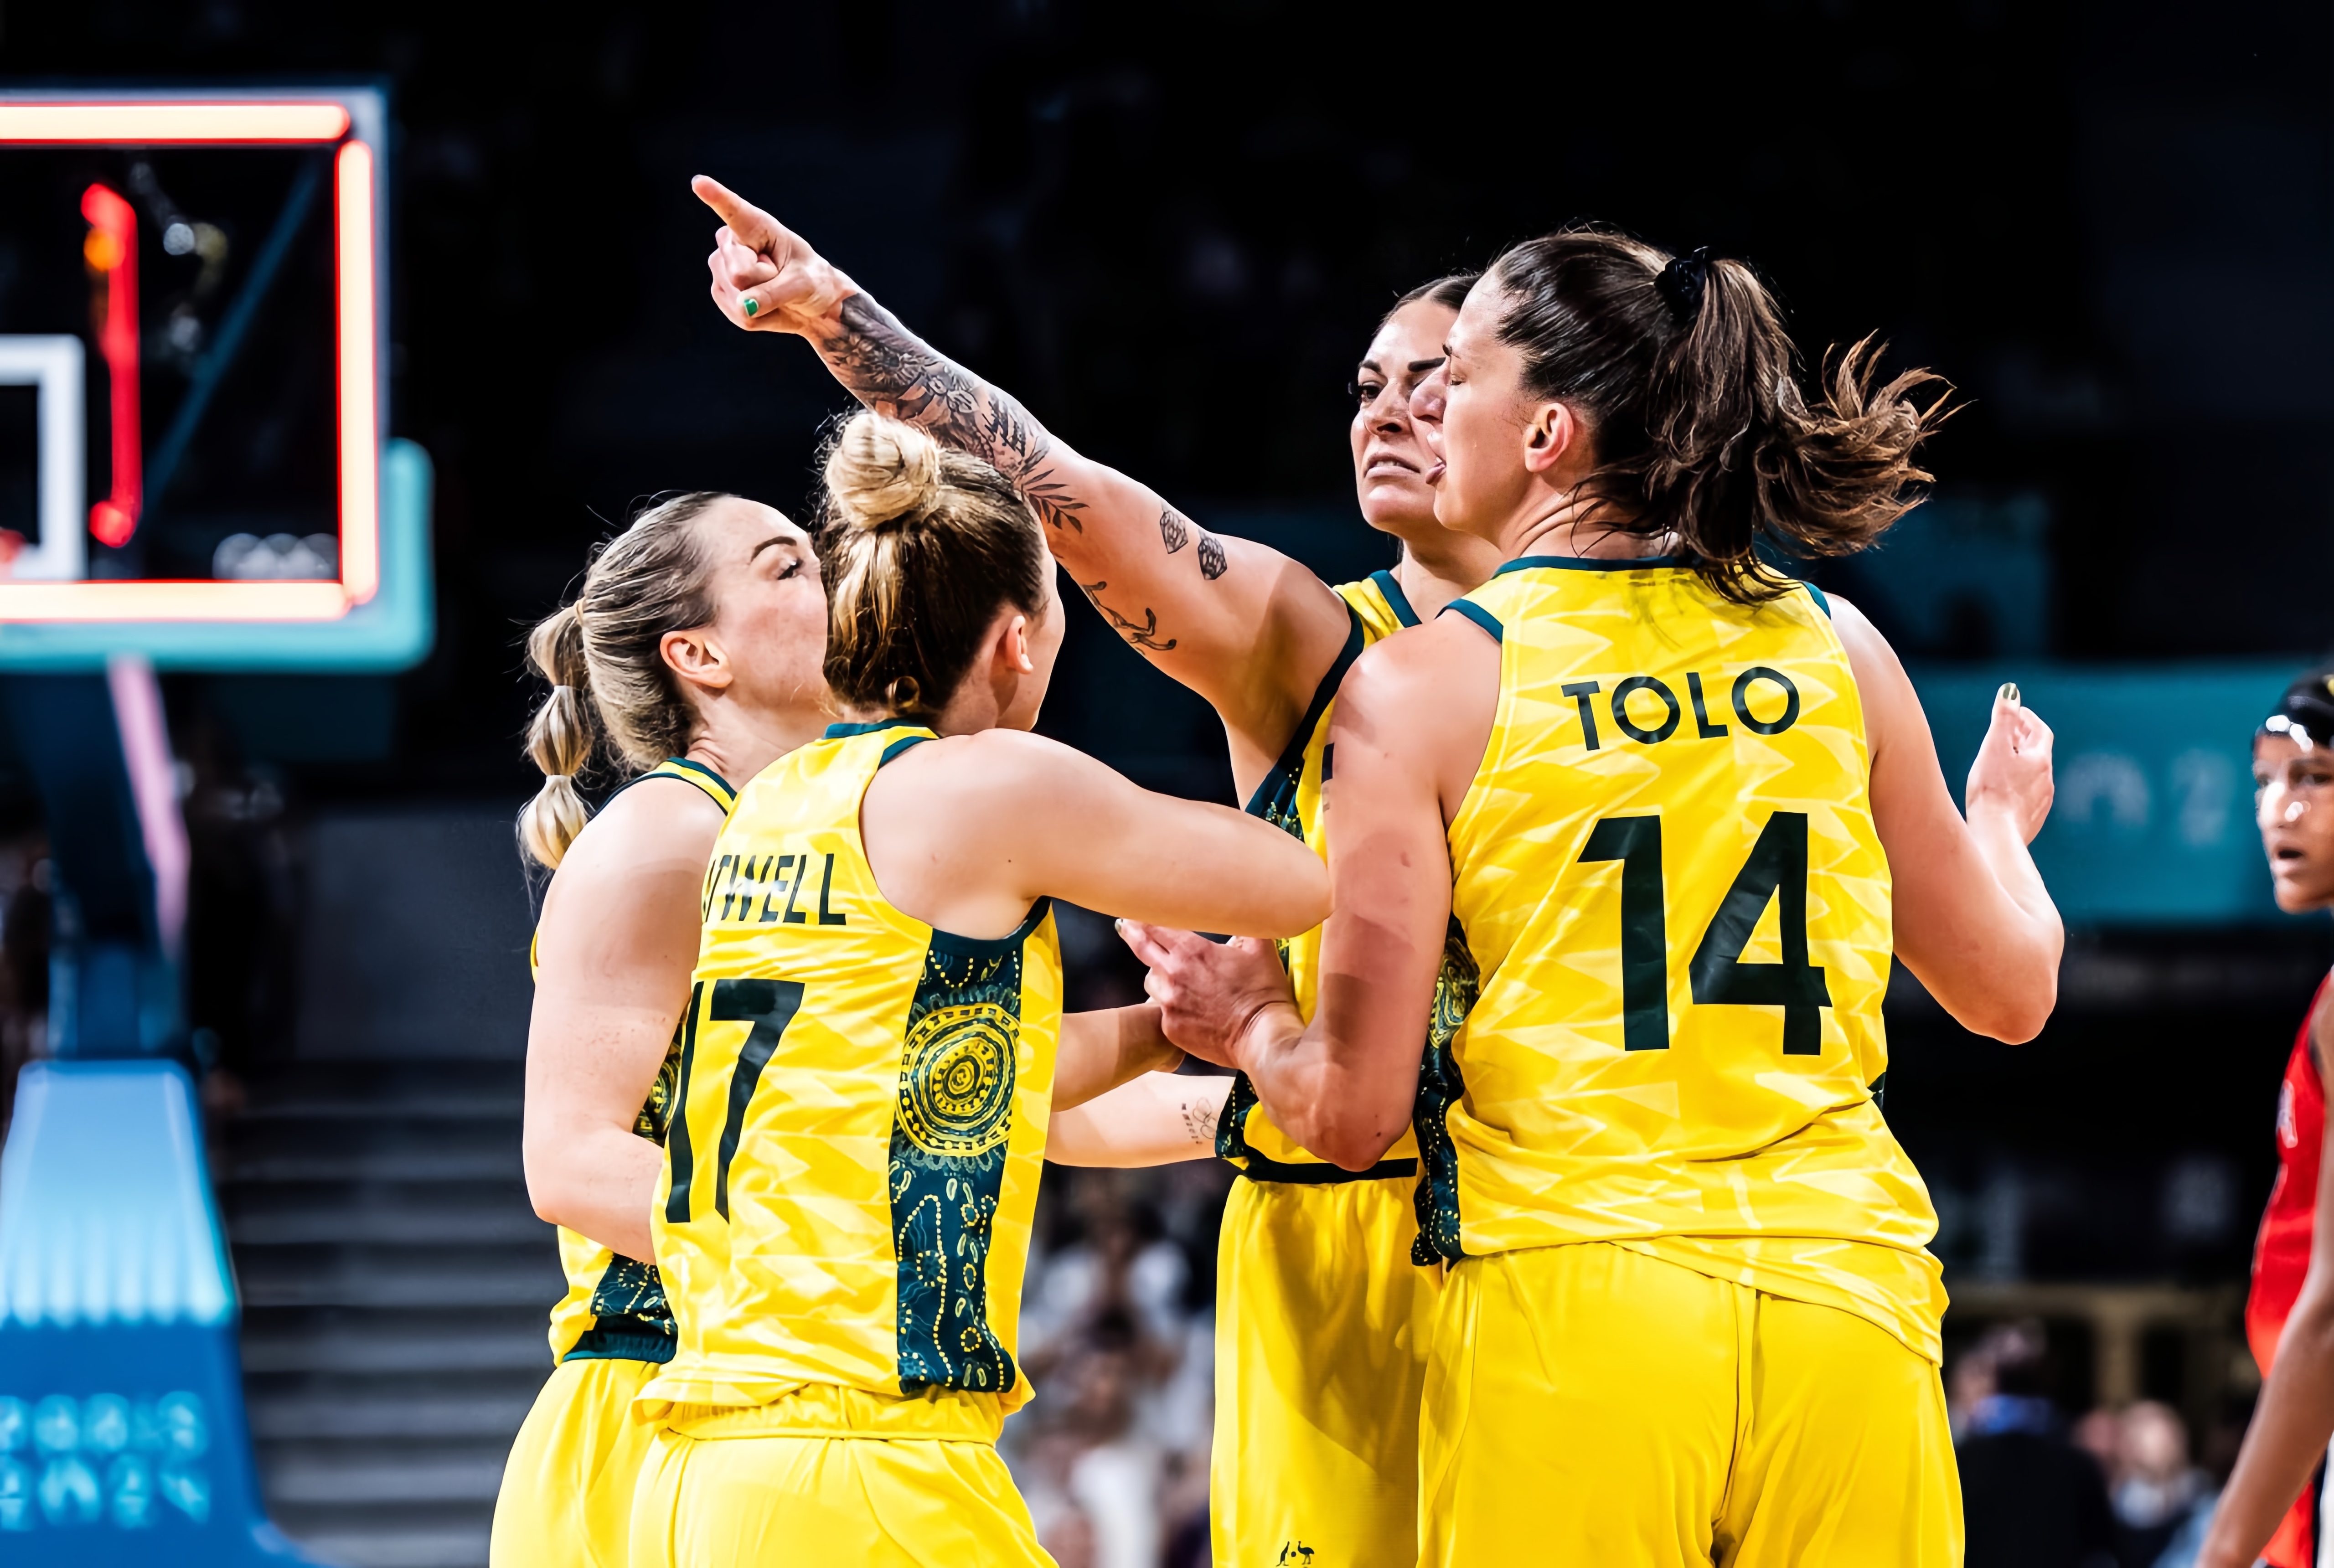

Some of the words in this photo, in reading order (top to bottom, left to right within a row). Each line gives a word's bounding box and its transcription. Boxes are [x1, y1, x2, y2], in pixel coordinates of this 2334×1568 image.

[1561, 666, 1800, 751] TOLO
[703, 853, 847, 925] TWELL
[1577, 811, 1833, 1056] 14
[665, 978, 806, 1225] 17
